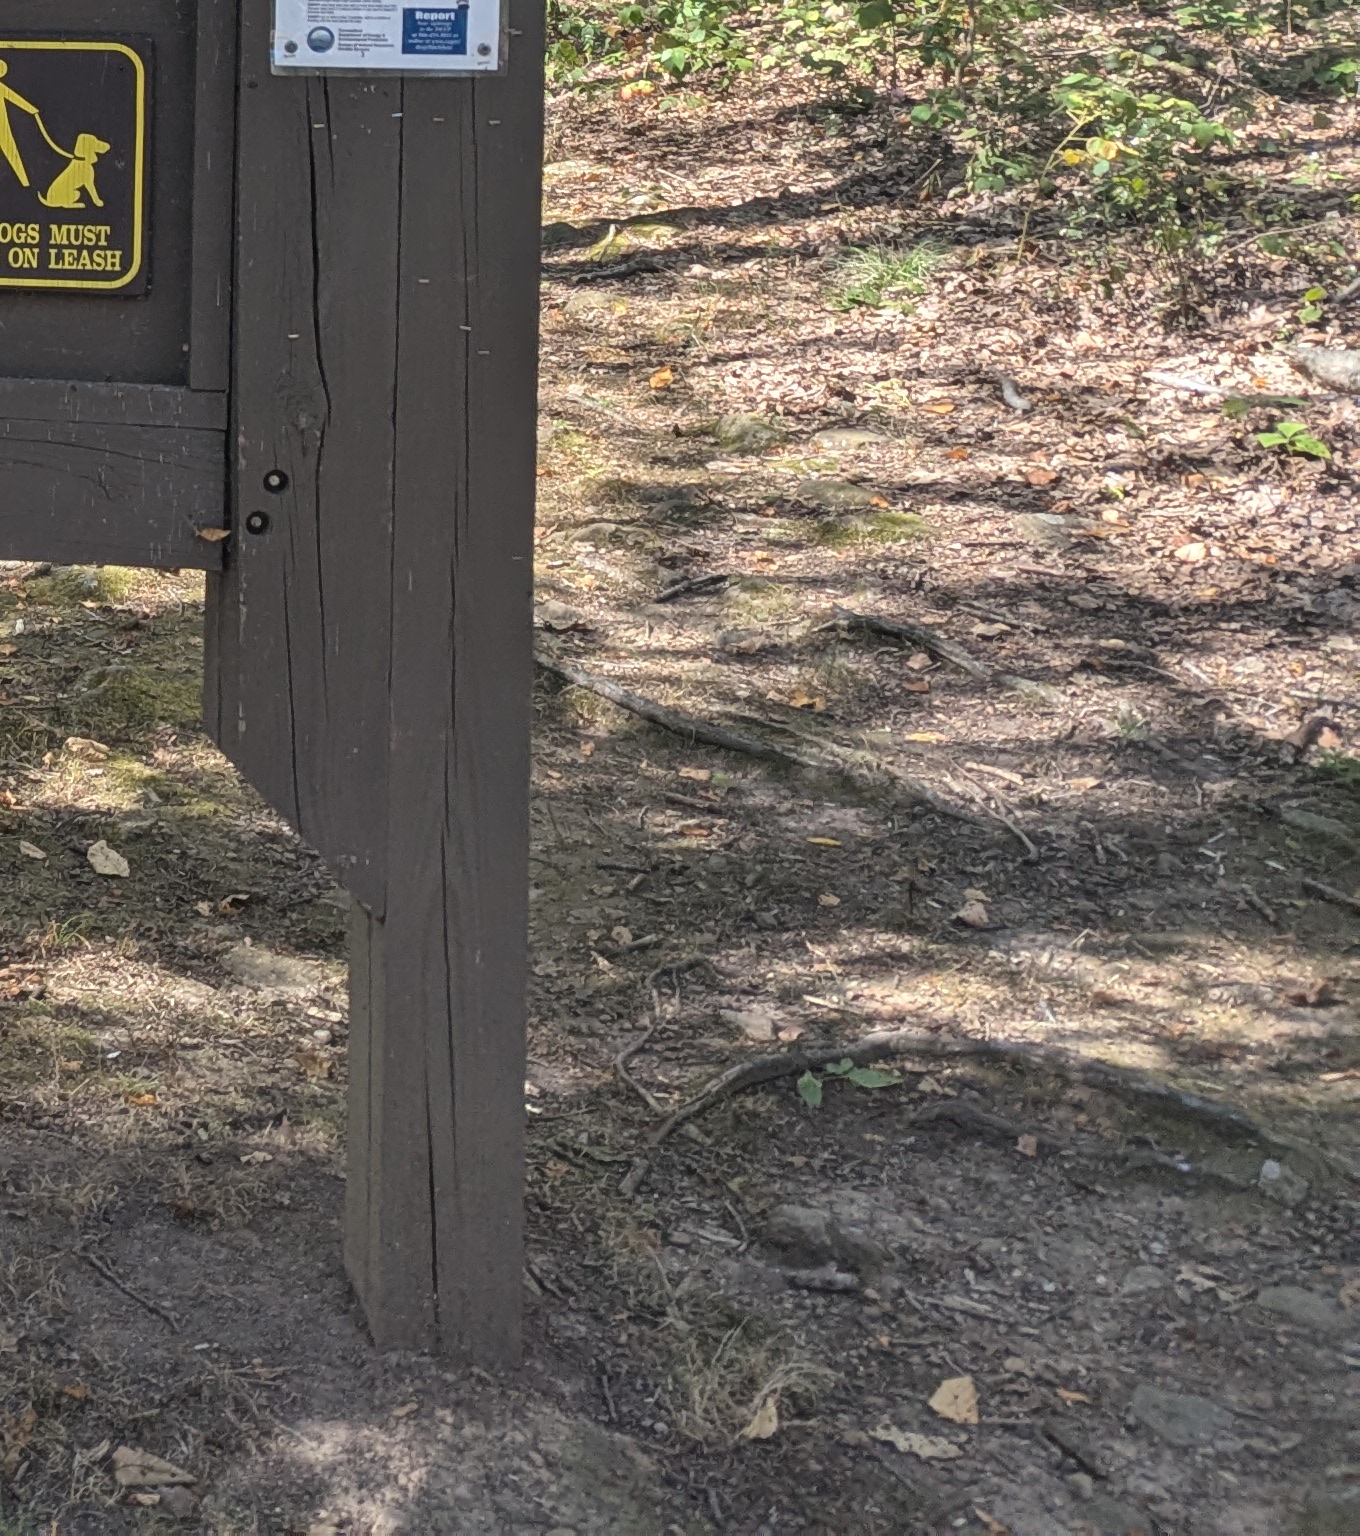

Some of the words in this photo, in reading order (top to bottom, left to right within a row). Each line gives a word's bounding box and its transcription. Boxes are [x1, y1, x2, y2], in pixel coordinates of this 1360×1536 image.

[415, 11, 455, 21] Report
[49, 224, 111, 246] MUST
[8, 247, 38, 269] ON
[48, 248, 123, 272] LEASH
